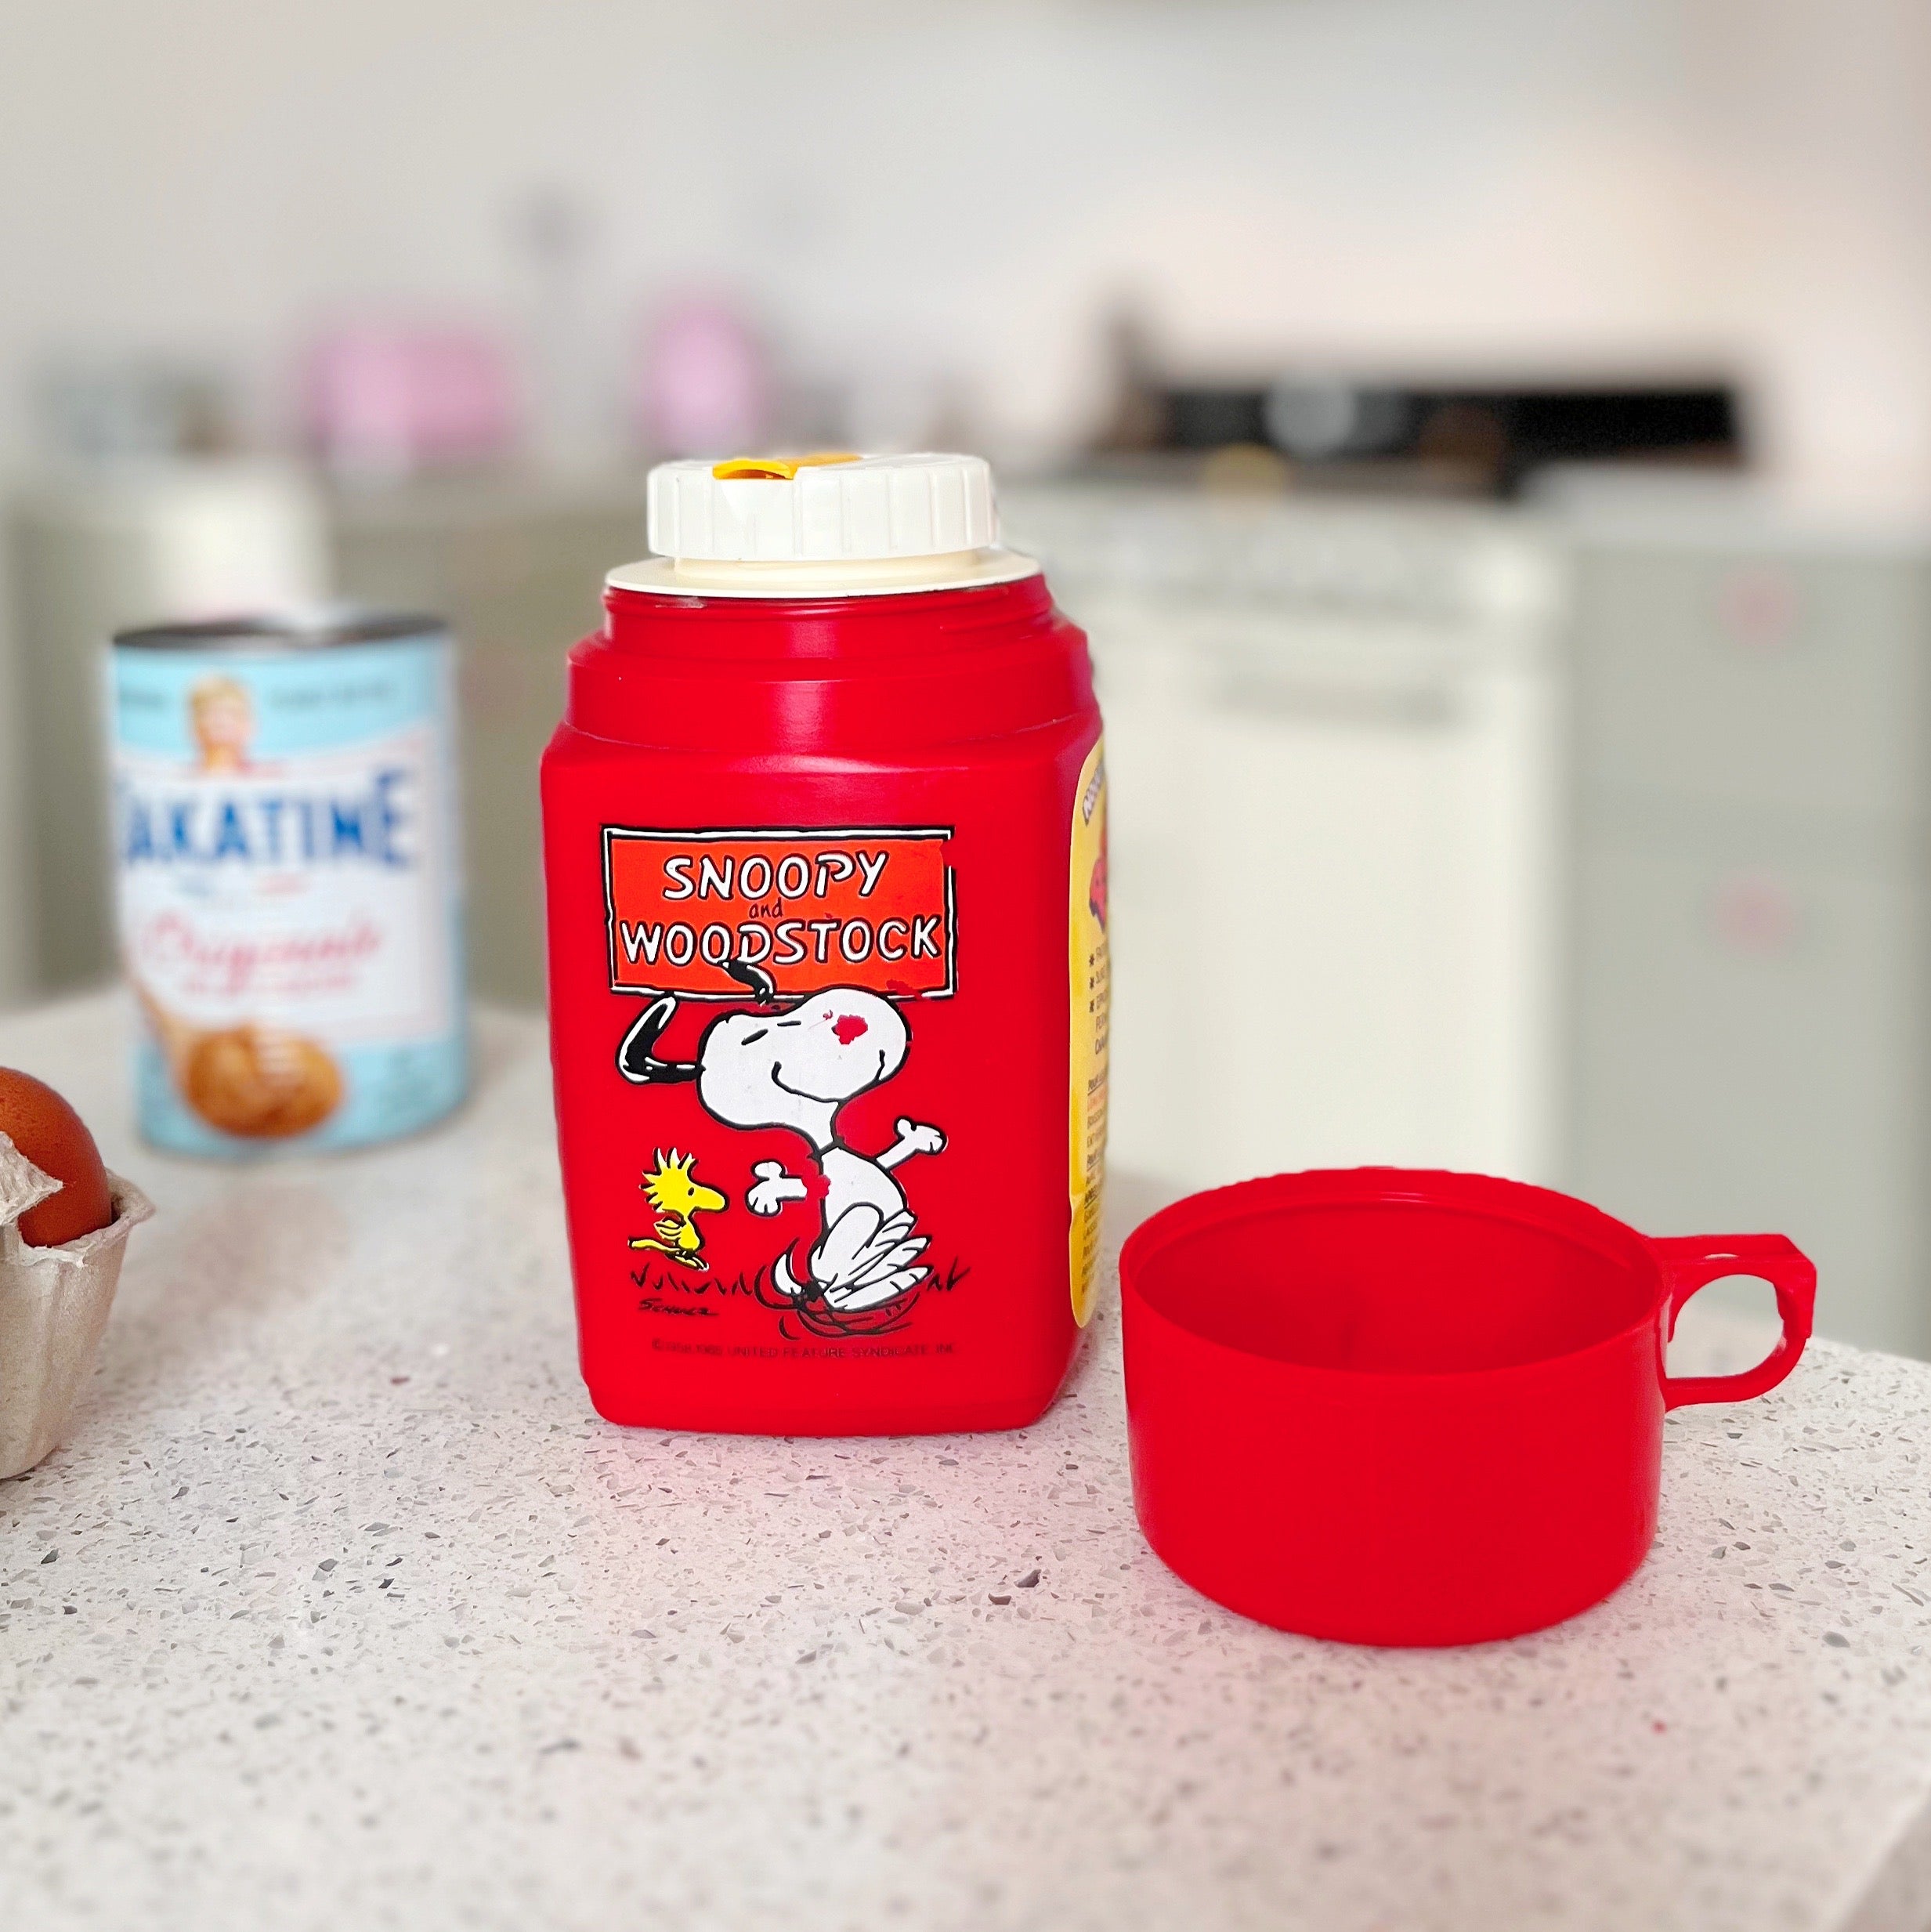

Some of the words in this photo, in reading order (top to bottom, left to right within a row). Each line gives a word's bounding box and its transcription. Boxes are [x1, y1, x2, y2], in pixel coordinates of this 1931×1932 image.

[662, 850, 890, 901] SNOOPY
[748, 897, 784, 919] and
[620, 913, 943, 967] WOODSTOCK
[727, 1344, 779, 1359] UNITED
[783, 1346, 847, 1359] FEATURE
